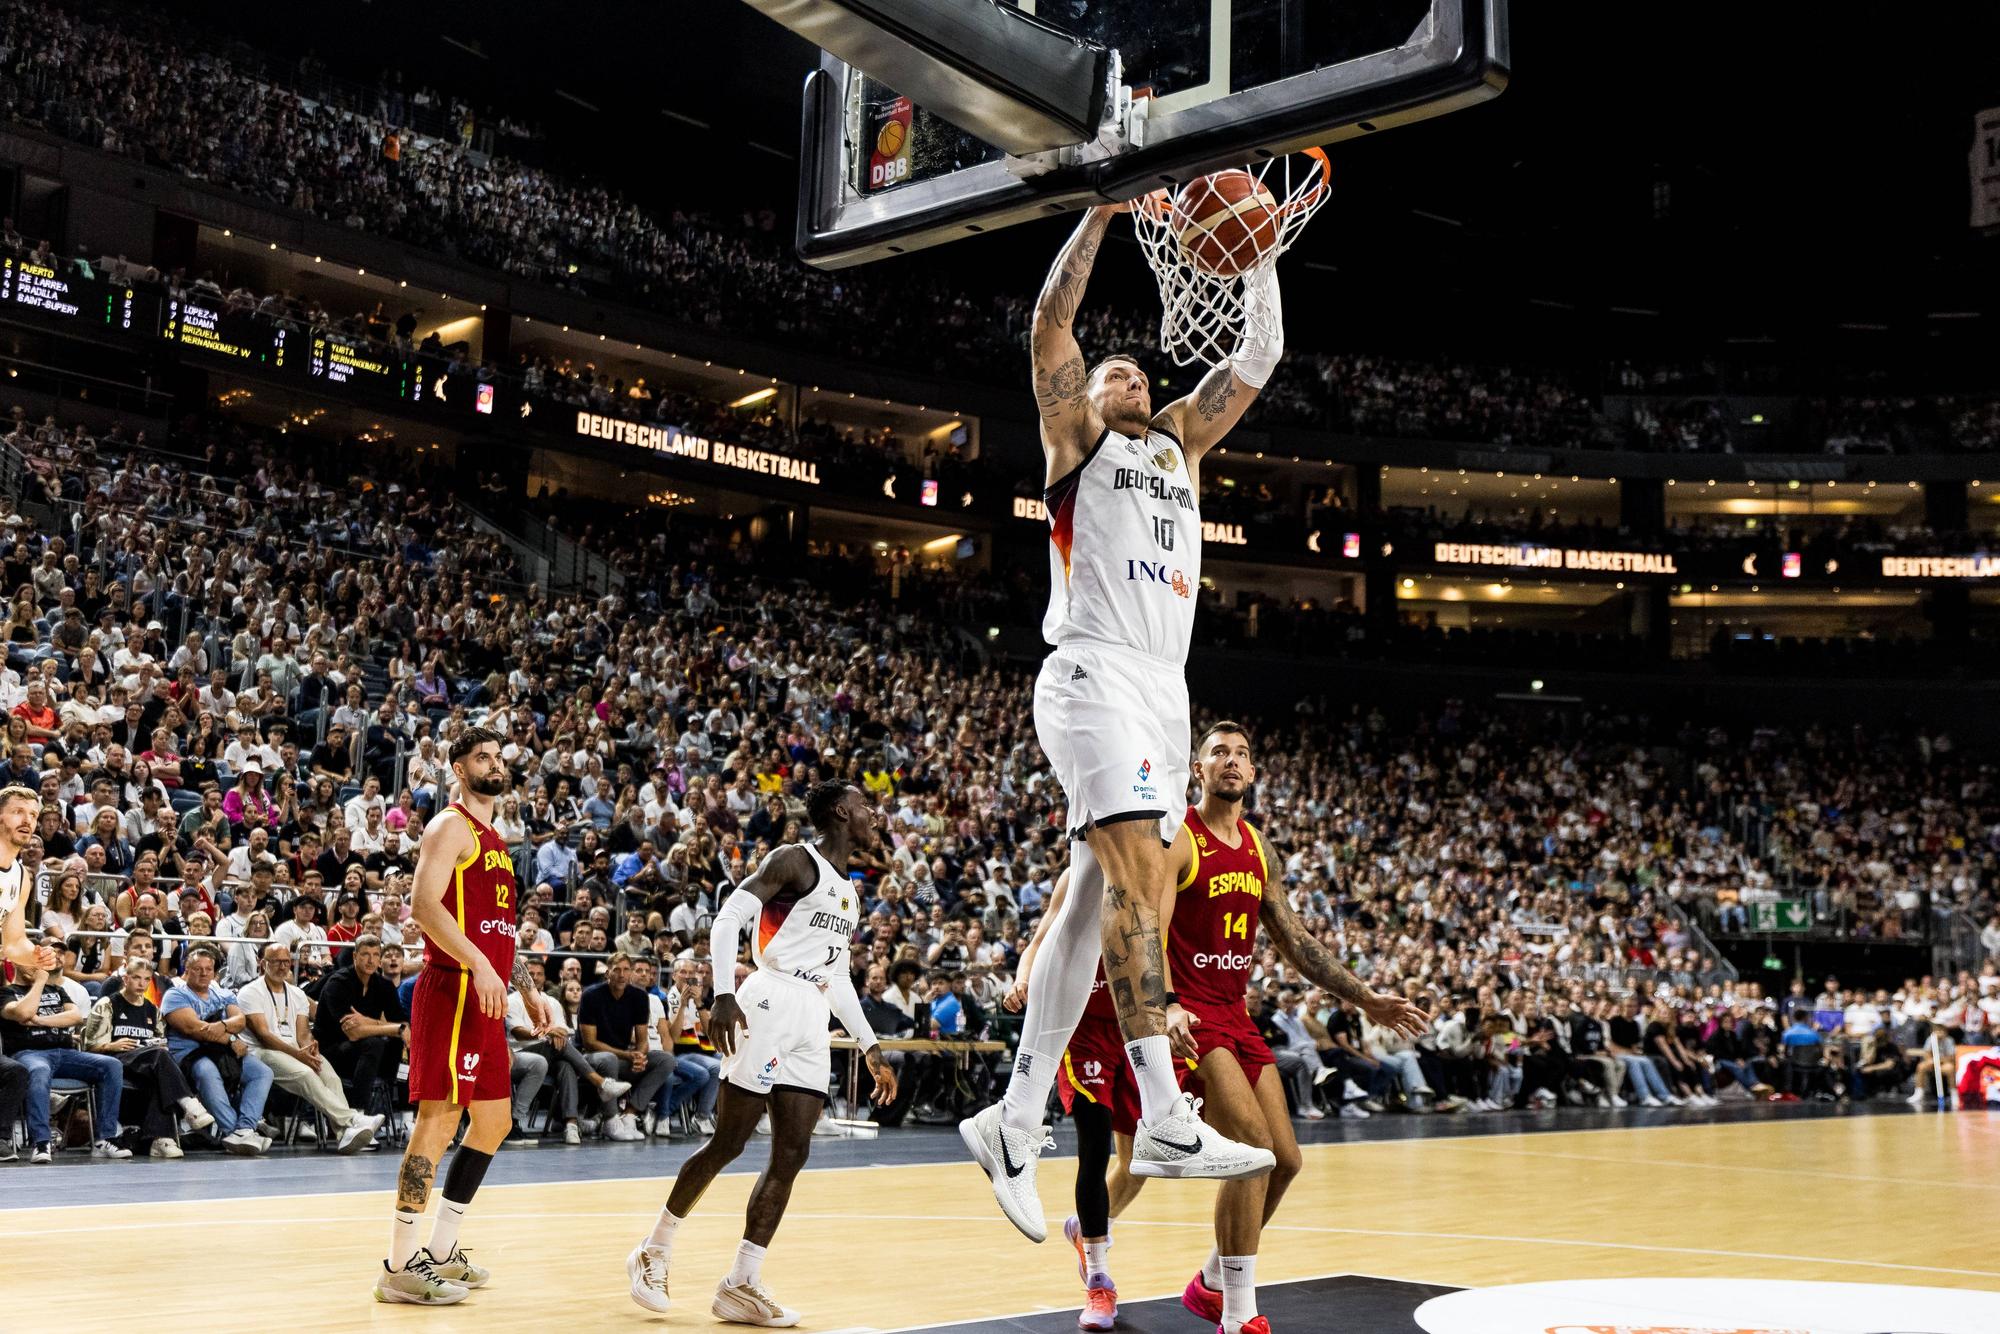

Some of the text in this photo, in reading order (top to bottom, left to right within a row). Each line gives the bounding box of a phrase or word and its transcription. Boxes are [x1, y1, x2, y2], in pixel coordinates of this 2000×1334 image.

[872, 158, 907, 184] DBB
[4, 269, 12, 279] 3
[19, 272, 32, 284] DE
[34, 278, 68, 293] LARREA
[124, 300, 132, 309] 2
[5, 258, 133, 299] 2 PUERTO 0
[4, 279, 10, 289] 4
[18, 283, 58, 300] PRADILLA
[124, 310, 132, 319] 3
[17, 293, 79, 315] SAINT-SUPERY
[123, 320, 131, 329] 0
[170, 311, 283, 347] 7 ALDAMA 11
[182, 324, 220, 341] BRIZUELA
[184, 304, 218, 321] LOPEZ-A
[278, 329, 286, 339] 0
[163, 329, 175, 340] 14
[241, 348, 251, 359] W
[276, 357, 284, 367] 0
[331, 343, 355, 357] YUSTA
[416, 365, 423, 375] 2
[311, 367, 323, 377] 77
[328, 370, 347, 383] SIMA
[413, 392, 421, 401] 2
[312, 358, 324, 368] 44
[329, 361, 354, 376] PARRA
[415, 383, 422, 393] 0
[313, 349, 324, 358] 41
[415, 374, 422, 384] 0
[577, 411, 821, 485] DEUTSCHLAND BASKETBALL
[1152, 514, 1175, 552] 10
[1434, 542, 1678, 574] DEUTSCHLAND BASKETBALL
[485, 849, 515, 878] ESPAÑA
[495, 883, 509, 909] 22
[1209, 871, 1262, 901] ESPAÑA
[1223, 912, 1248, 940] 14
[824, 945, 842, 967] 17
